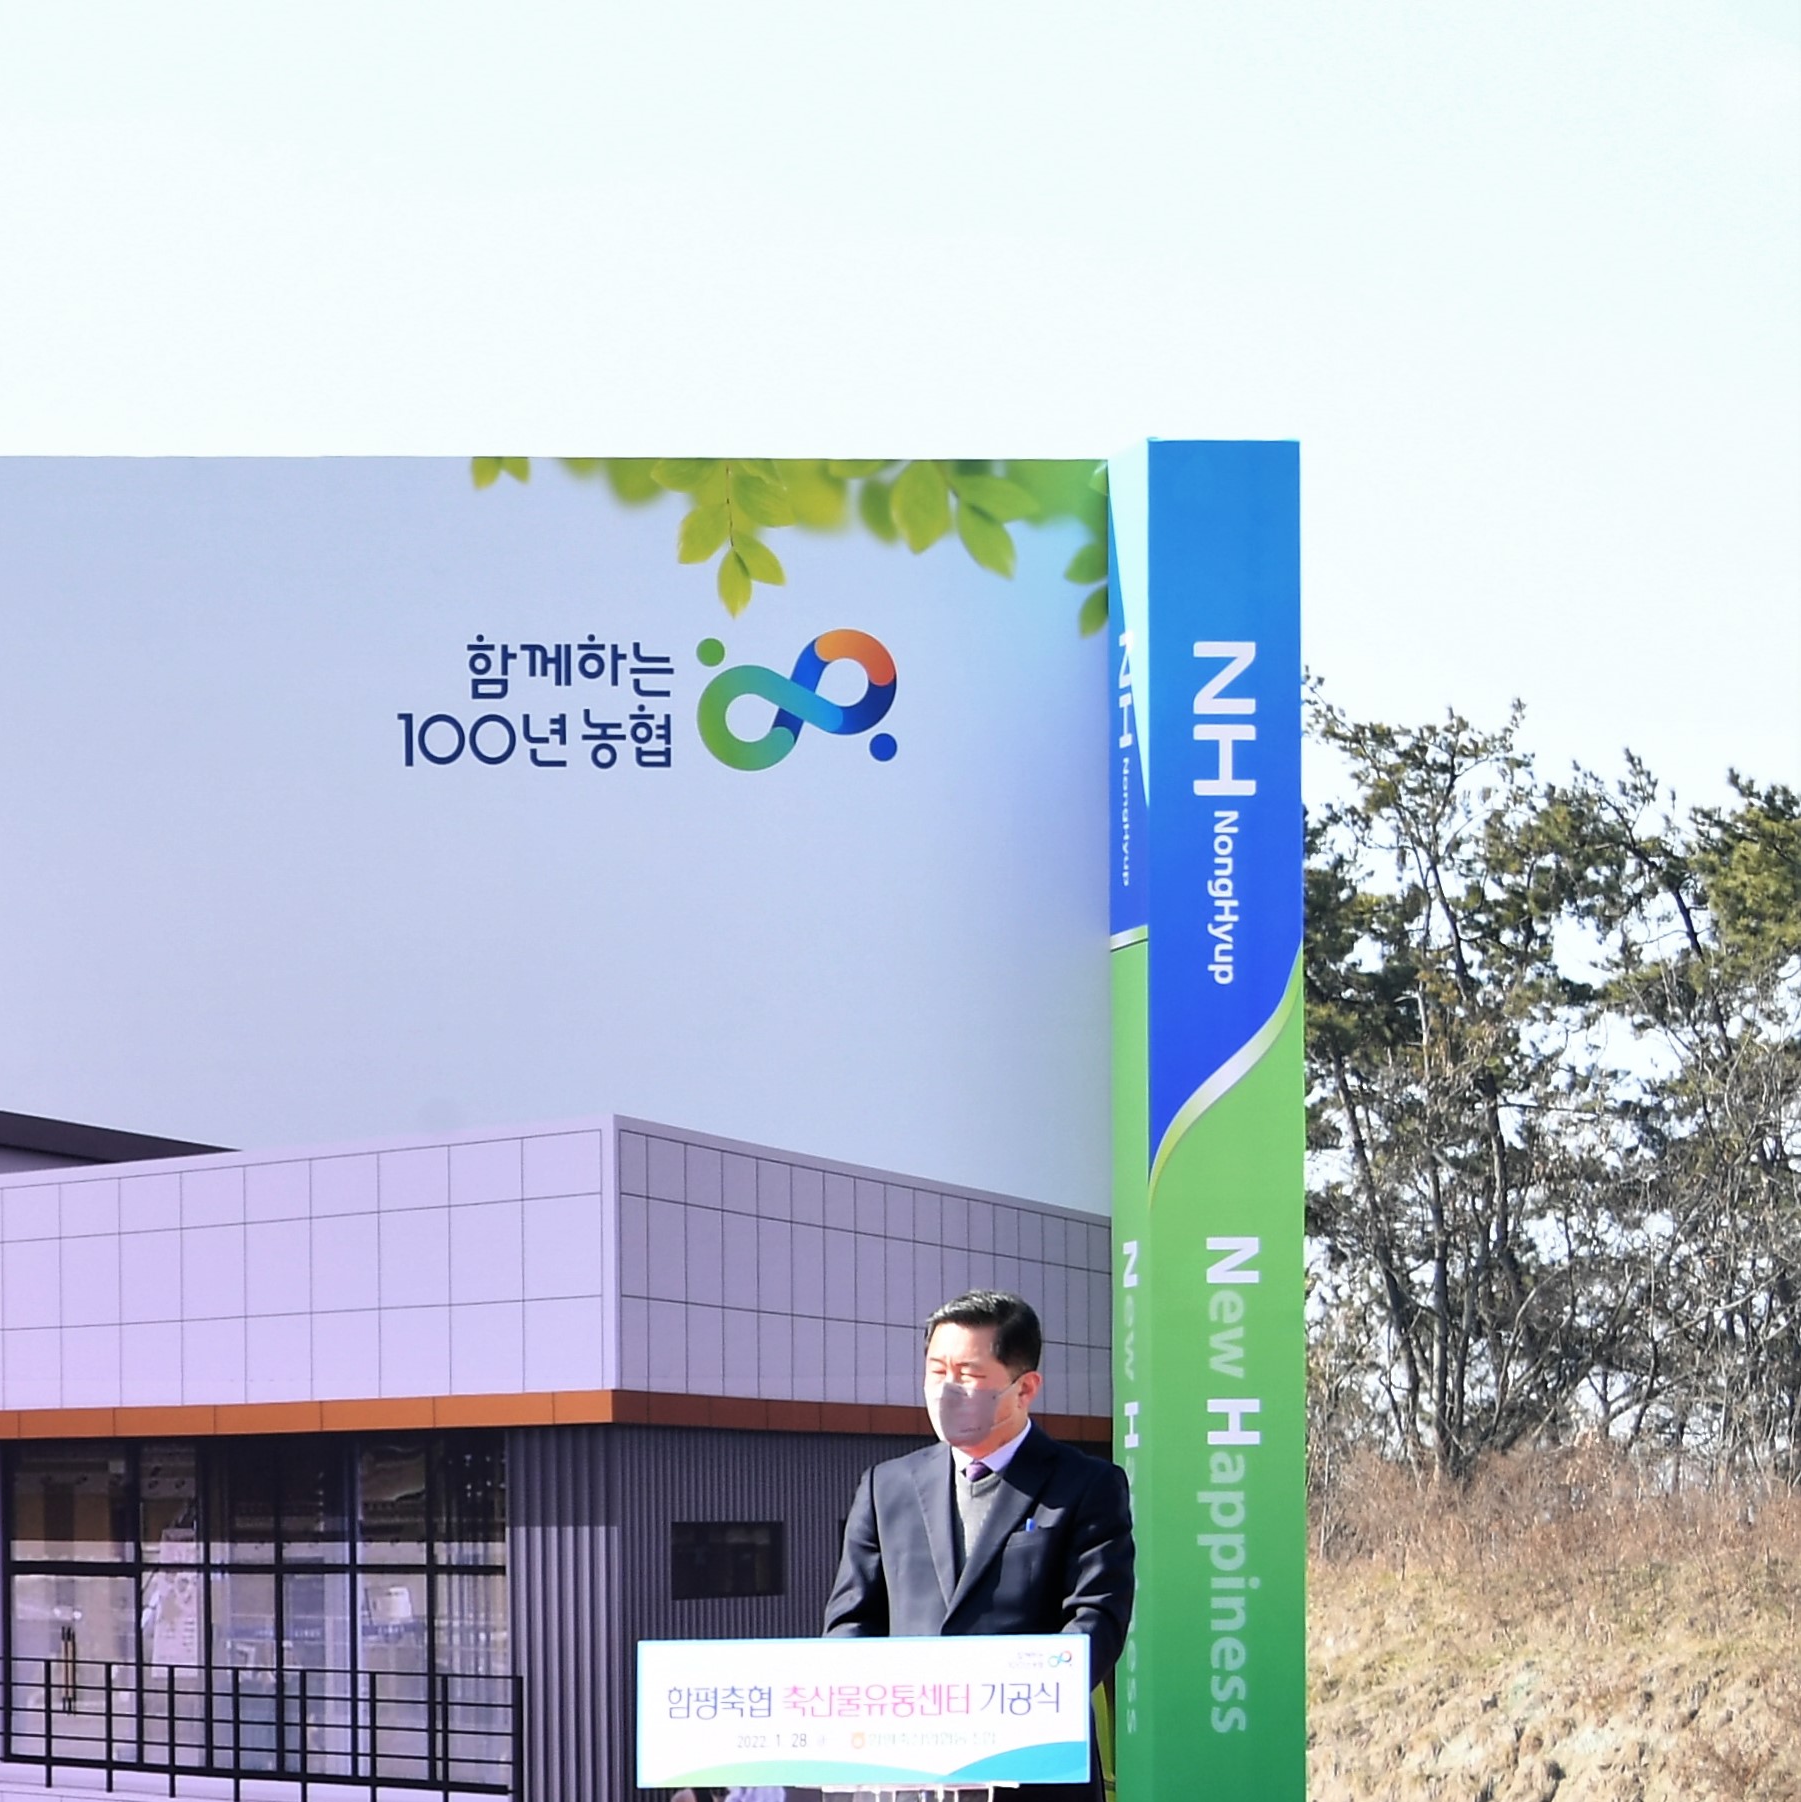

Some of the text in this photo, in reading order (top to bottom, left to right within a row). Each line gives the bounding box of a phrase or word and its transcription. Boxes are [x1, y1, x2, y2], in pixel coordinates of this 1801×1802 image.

[467, 634, 675, 700] 함께하는
[397, 704, 673, 770] 100년 농협
[1193, 640, 1256, 986] NH NongHyup
[1197, 1237, 1260, 1733] New Happiness
[667, 1682, 1060, 1720] 함평축협 축산물유통센터 기공식
